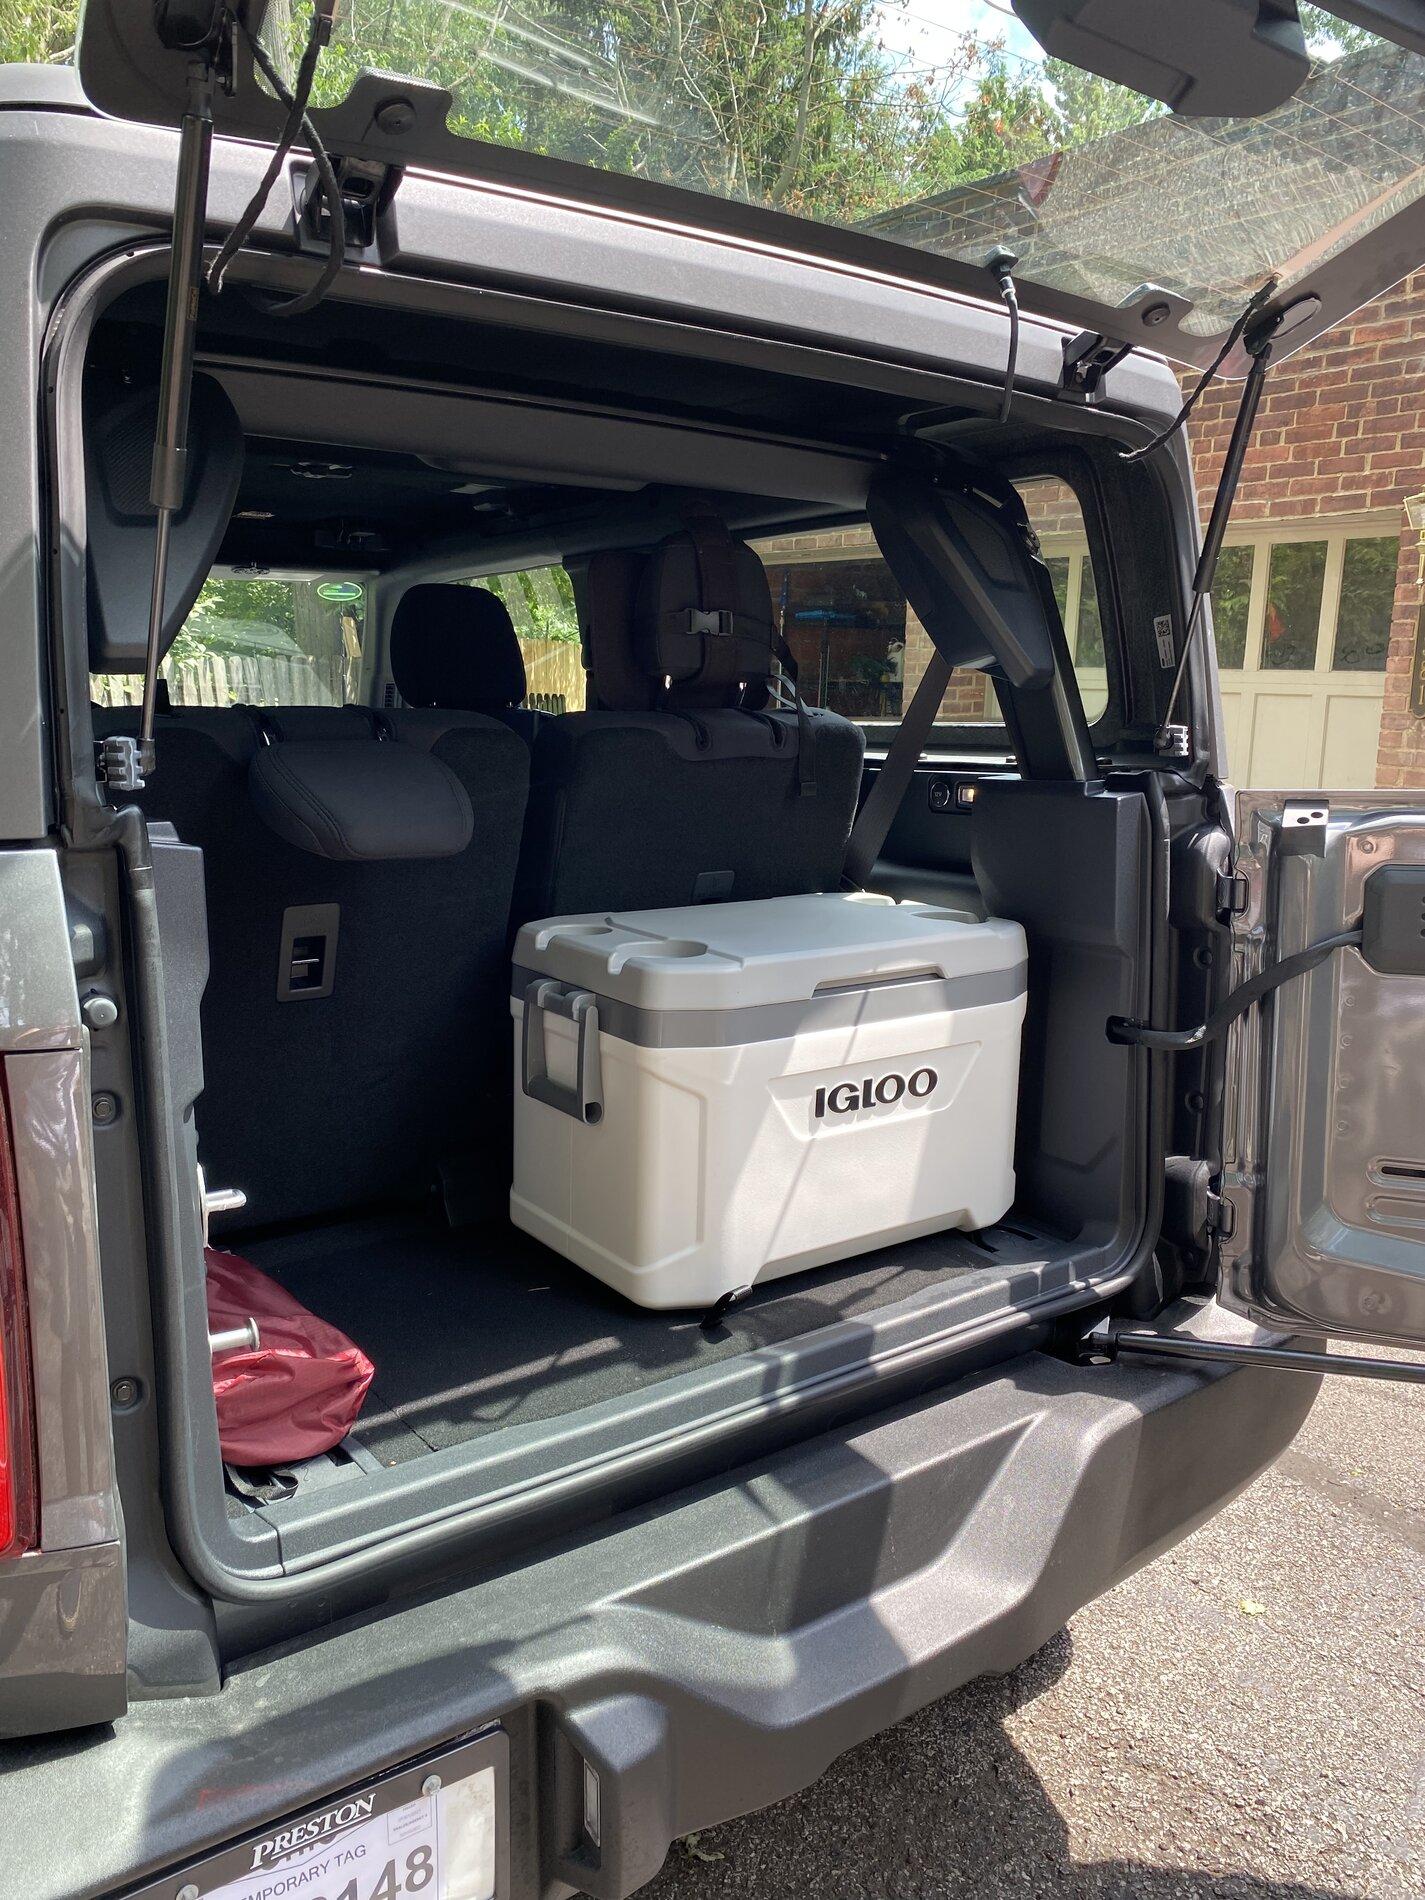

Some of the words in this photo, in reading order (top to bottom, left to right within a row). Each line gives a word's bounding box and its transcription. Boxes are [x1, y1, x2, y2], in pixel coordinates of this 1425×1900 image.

[814, 1068, 938, 1118] IGLOO
[249, 1794, 376, 1870] PRESTON
[241, 1859, 330, 1900] MPORARY
[334, 1844, 366, 1868] TAG
[311, 1844, 434, 1900] 148
